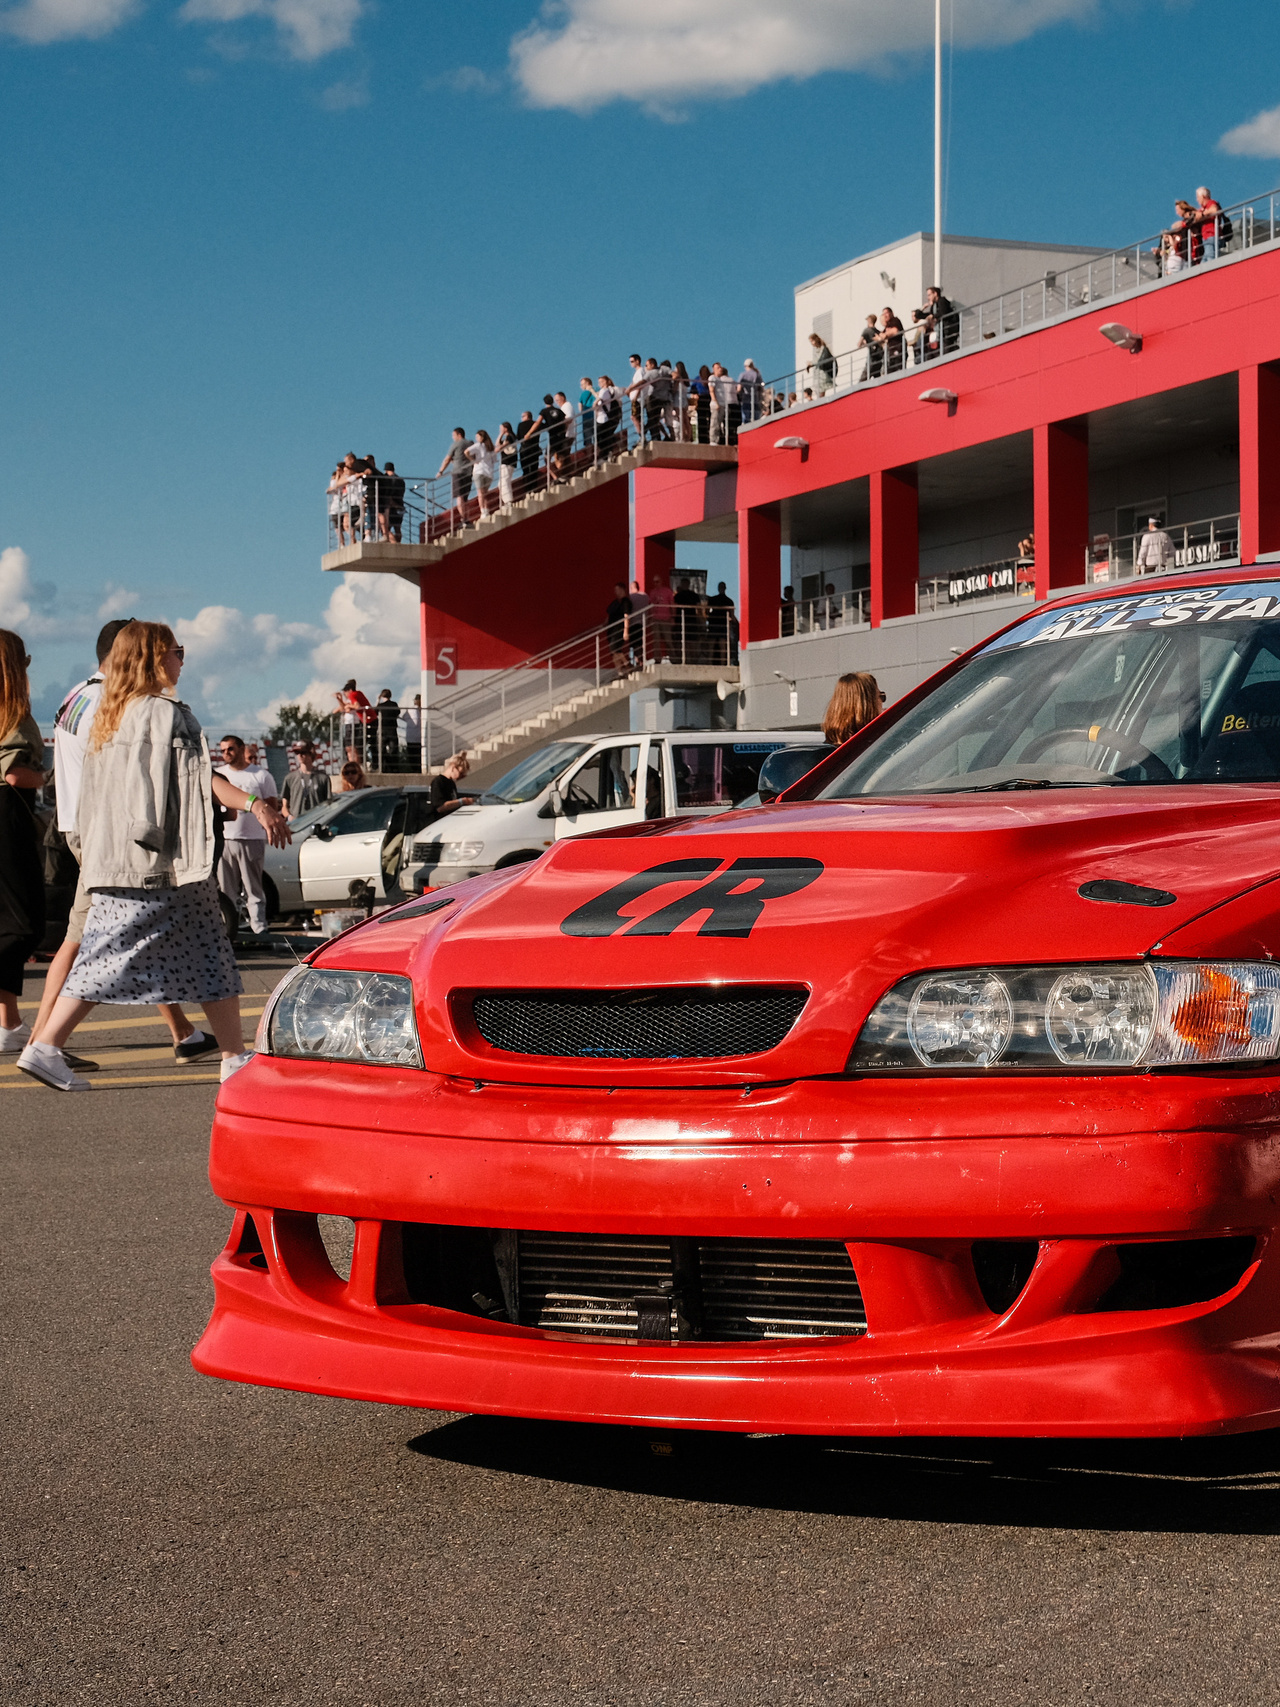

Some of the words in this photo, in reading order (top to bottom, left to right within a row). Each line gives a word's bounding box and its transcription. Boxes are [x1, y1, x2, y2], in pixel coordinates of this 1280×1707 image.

[1057, 600, 1132, 620] DRIFT
[1137, 589, 1220, 608] EXPO
[1019, 617, 1133, 647] ALL
[436, 647, 455, 681] 5
[559, 857, 825, 939] CR
